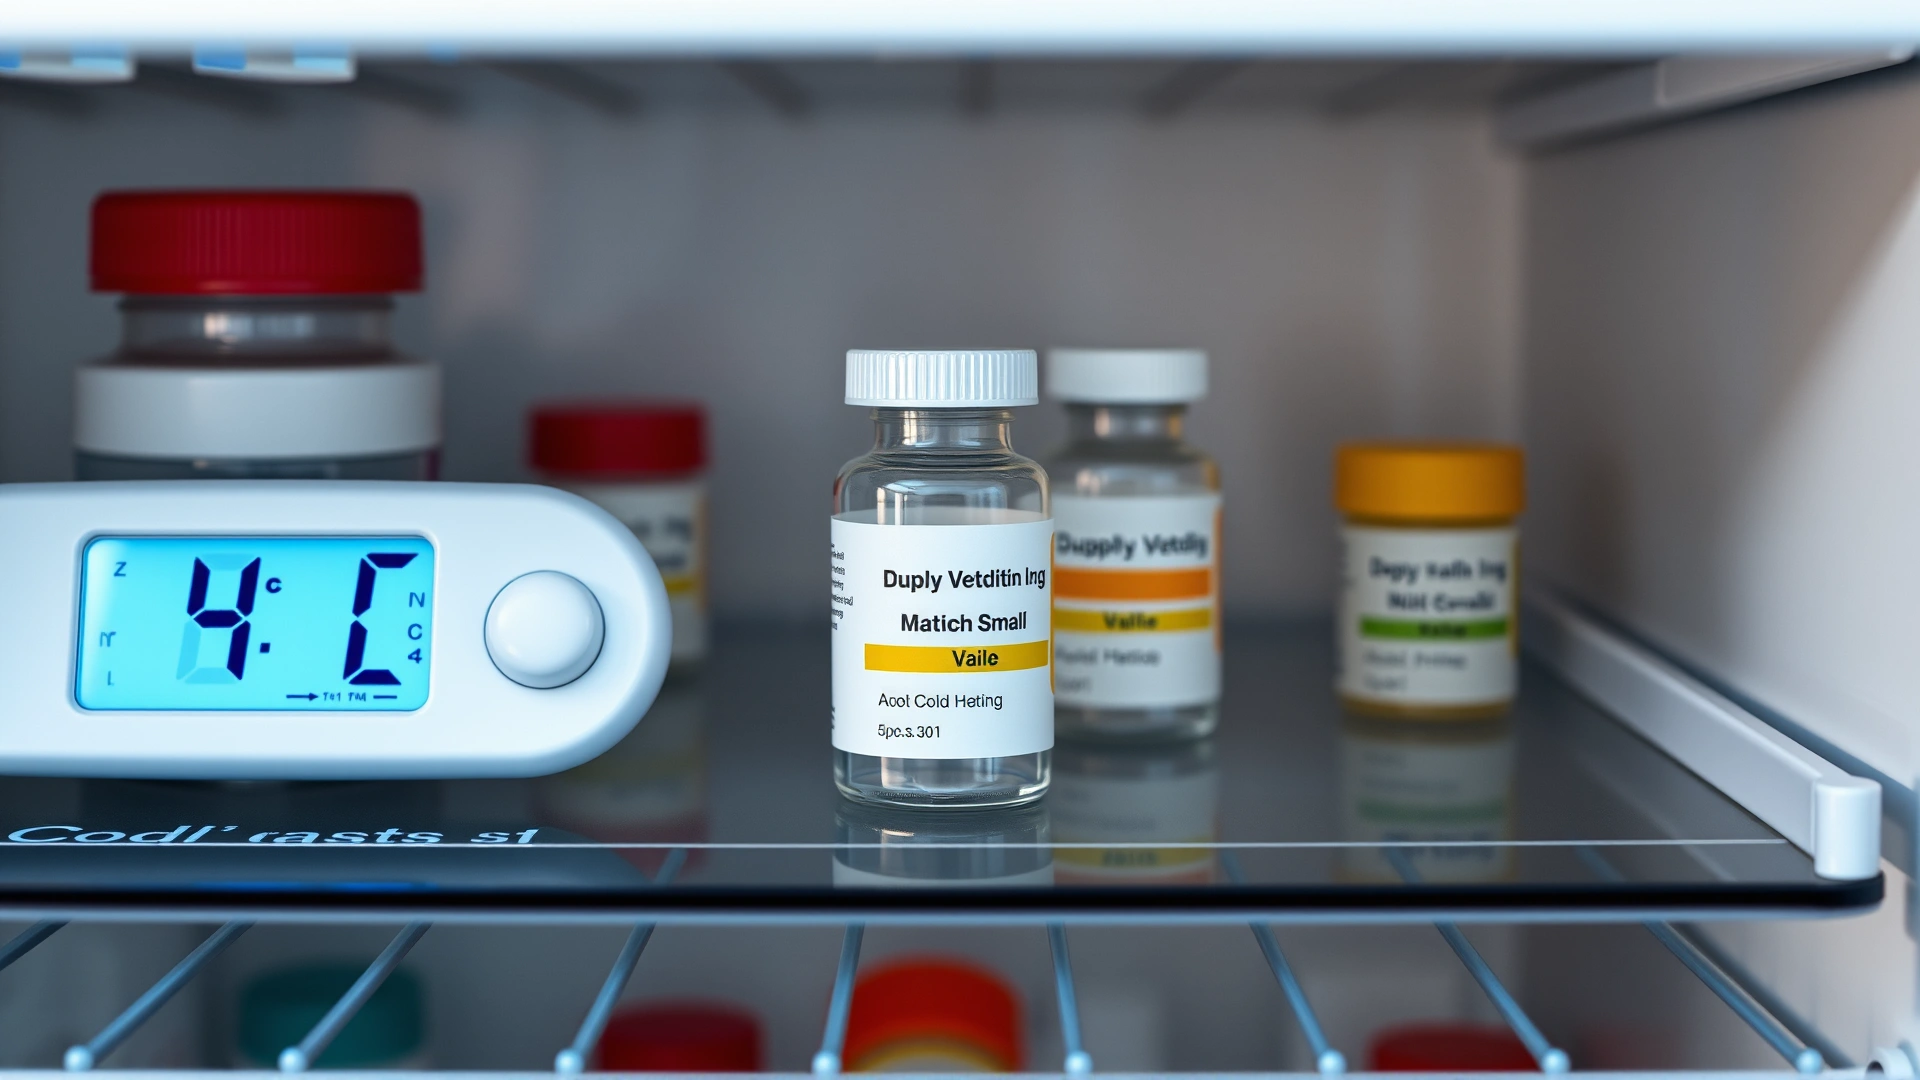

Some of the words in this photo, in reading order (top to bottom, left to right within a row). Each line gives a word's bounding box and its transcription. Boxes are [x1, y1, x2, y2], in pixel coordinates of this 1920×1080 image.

[883, 569, 942, 593] Duply
[901, 613, 973, 632] Matich
[977, 611, 1027, 632] Small
[952, 649, 999, 667] Vaile
[914, 693, 950, 708] Cold
